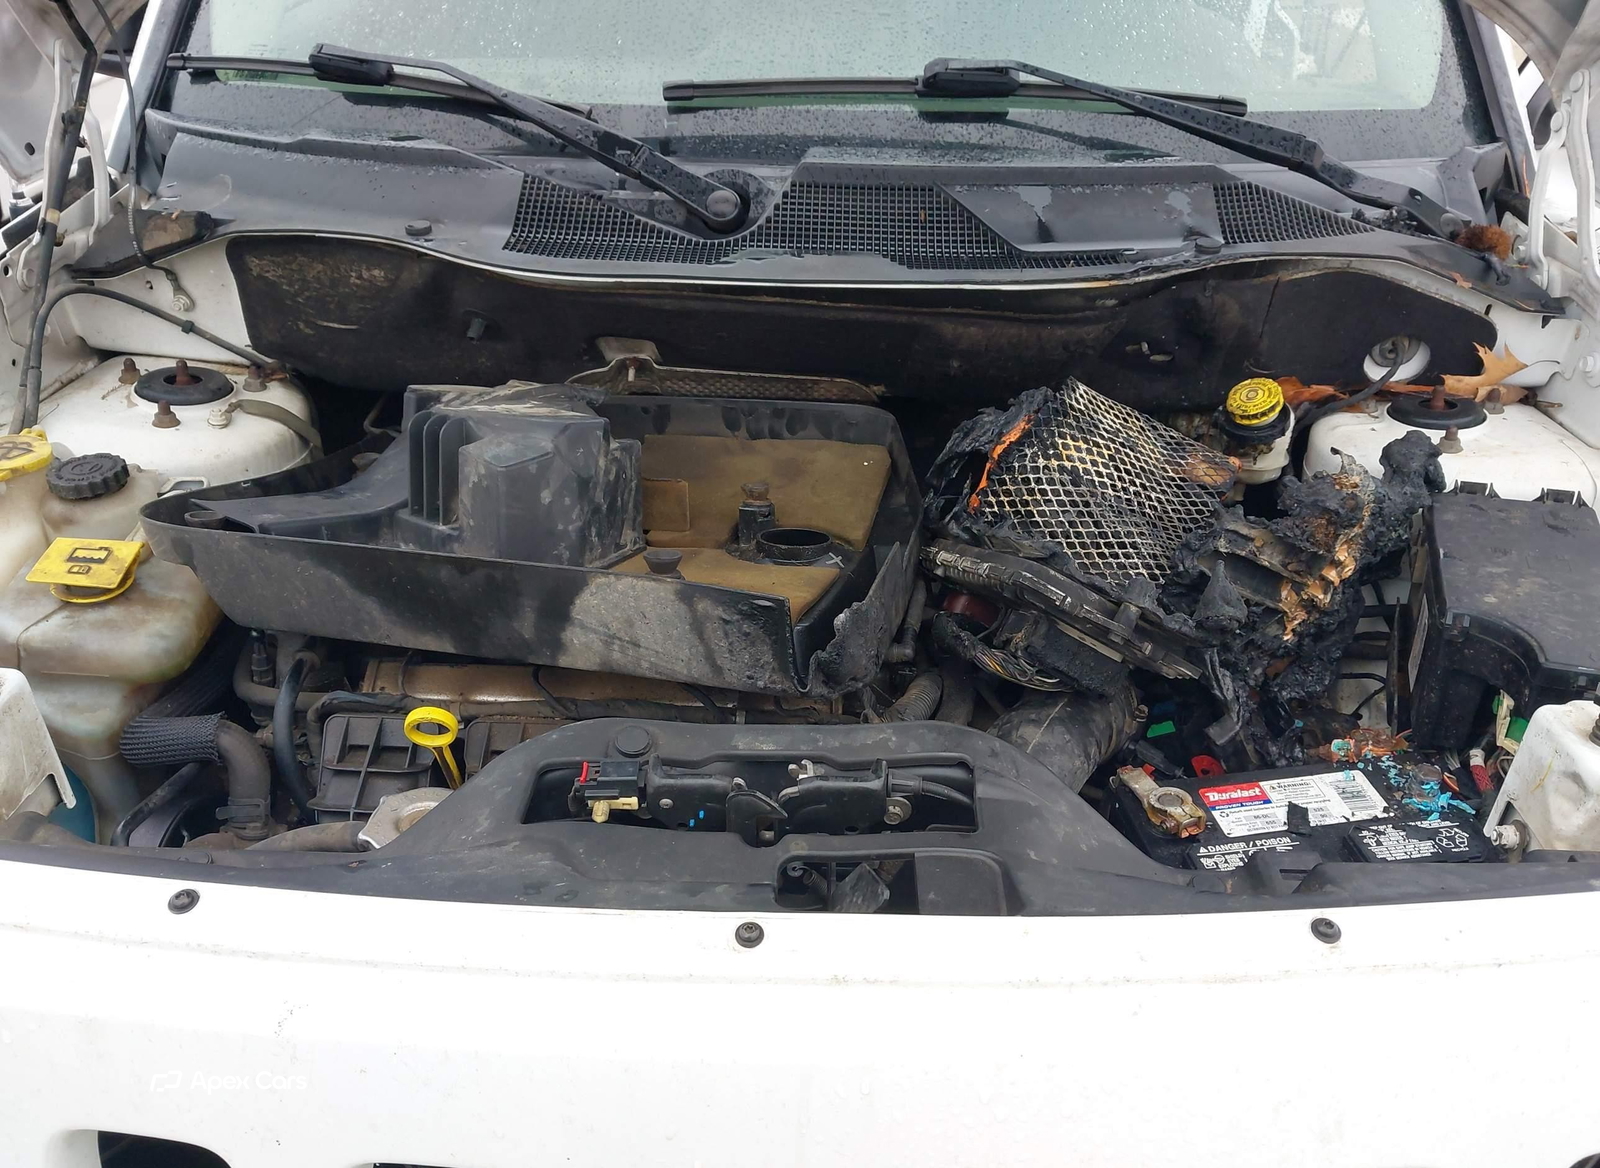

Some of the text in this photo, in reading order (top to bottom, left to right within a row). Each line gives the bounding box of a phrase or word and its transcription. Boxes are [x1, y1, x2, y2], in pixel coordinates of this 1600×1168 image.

[1205, 788, 1262, 802] Duralast
[1207, 841, 1248, 853] DANGER
[1255, 836, 1291, 847] POISON
